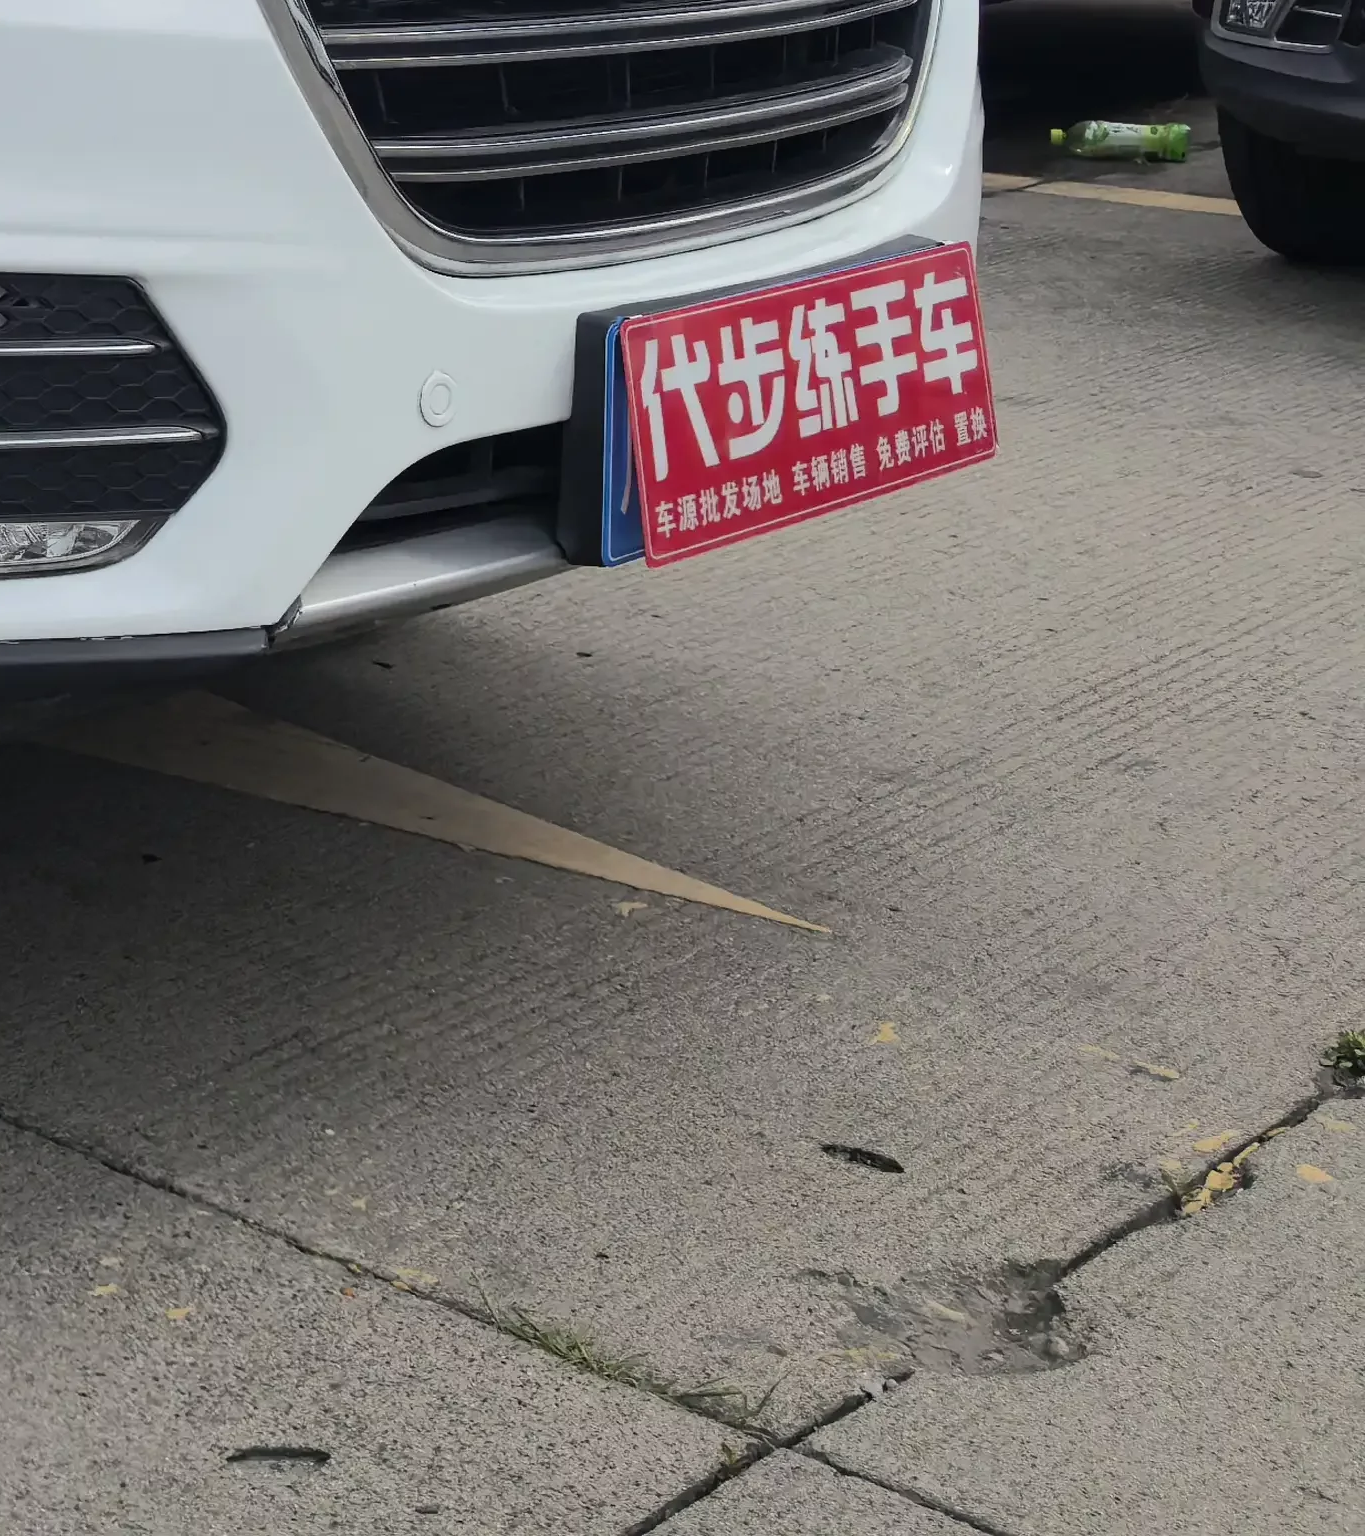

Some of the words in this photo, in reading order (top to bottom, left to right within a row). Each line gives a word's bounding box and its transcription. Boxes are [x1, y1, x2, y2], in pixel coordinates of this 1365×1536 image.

[640, 271, 979, 482] 代步练手车
[655, 469, 783, 538] 车源批发场地
[791, 443, 866, 496] 车辆销售
[876, 418, 946, 472] 免费评估
[954, 406, 988, 446] 置换
